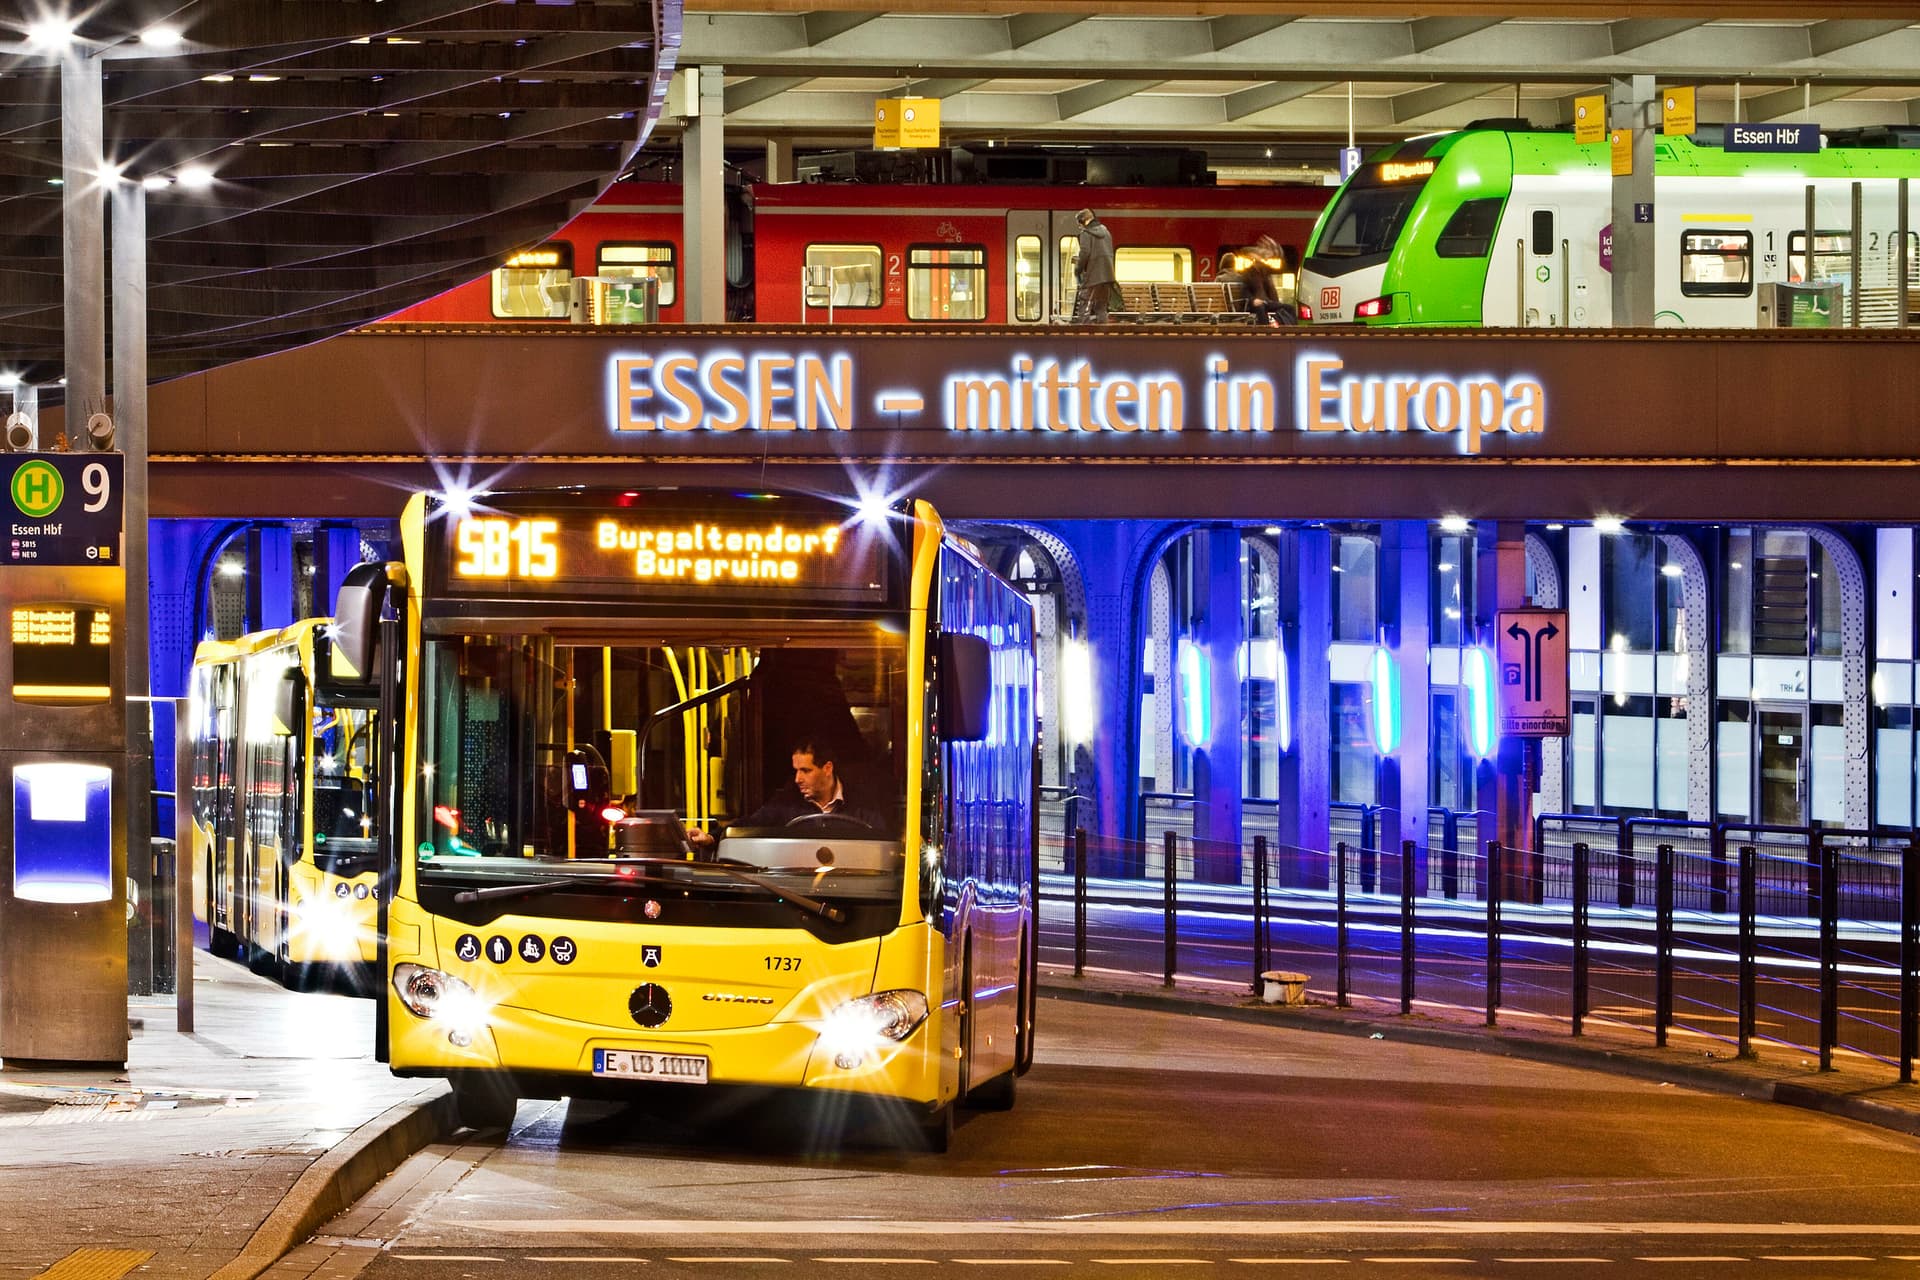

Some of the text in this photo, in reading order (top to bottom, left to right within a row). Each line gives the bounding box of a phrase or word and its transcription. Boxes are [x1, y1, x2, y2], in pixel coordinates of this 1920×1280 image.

[1734, 128, 1800, 144] Essen Hbf
[1347, 150, 1359, 177] B
[956, 232, 962, 243] 6
[1766, 231, 1773, 251] 1
[1868, 232, 1879, 250] 2
[889, 255, 900, 275] 2
[1200, 257, 1211, 277] 2
[1322, 289, 1338, 307] DB
[612, 356, 853, 432] ESSEN
[950, 357, 1184, 433] mitten
[1213, 357, 1274, 433] in
[1302, 357, 1545, 454] Europa
[81, 463, 110, 512] 9
[12, 524, 62, 535] Essen Hbf
[457, 518, 840, 578] SB15 Burgaltendorf
[636, 551, 798, 581] Burgruine
[1508, 671, 1517, 683] P
[1780, 670, 1805, 692] TRH 2
[1502, 719, 1519, 730] Bitte
[764, 956, 802, 972] 1737
[702, 993, 774, 1005] CITARO
[605, 1053, 617, 1072] E
